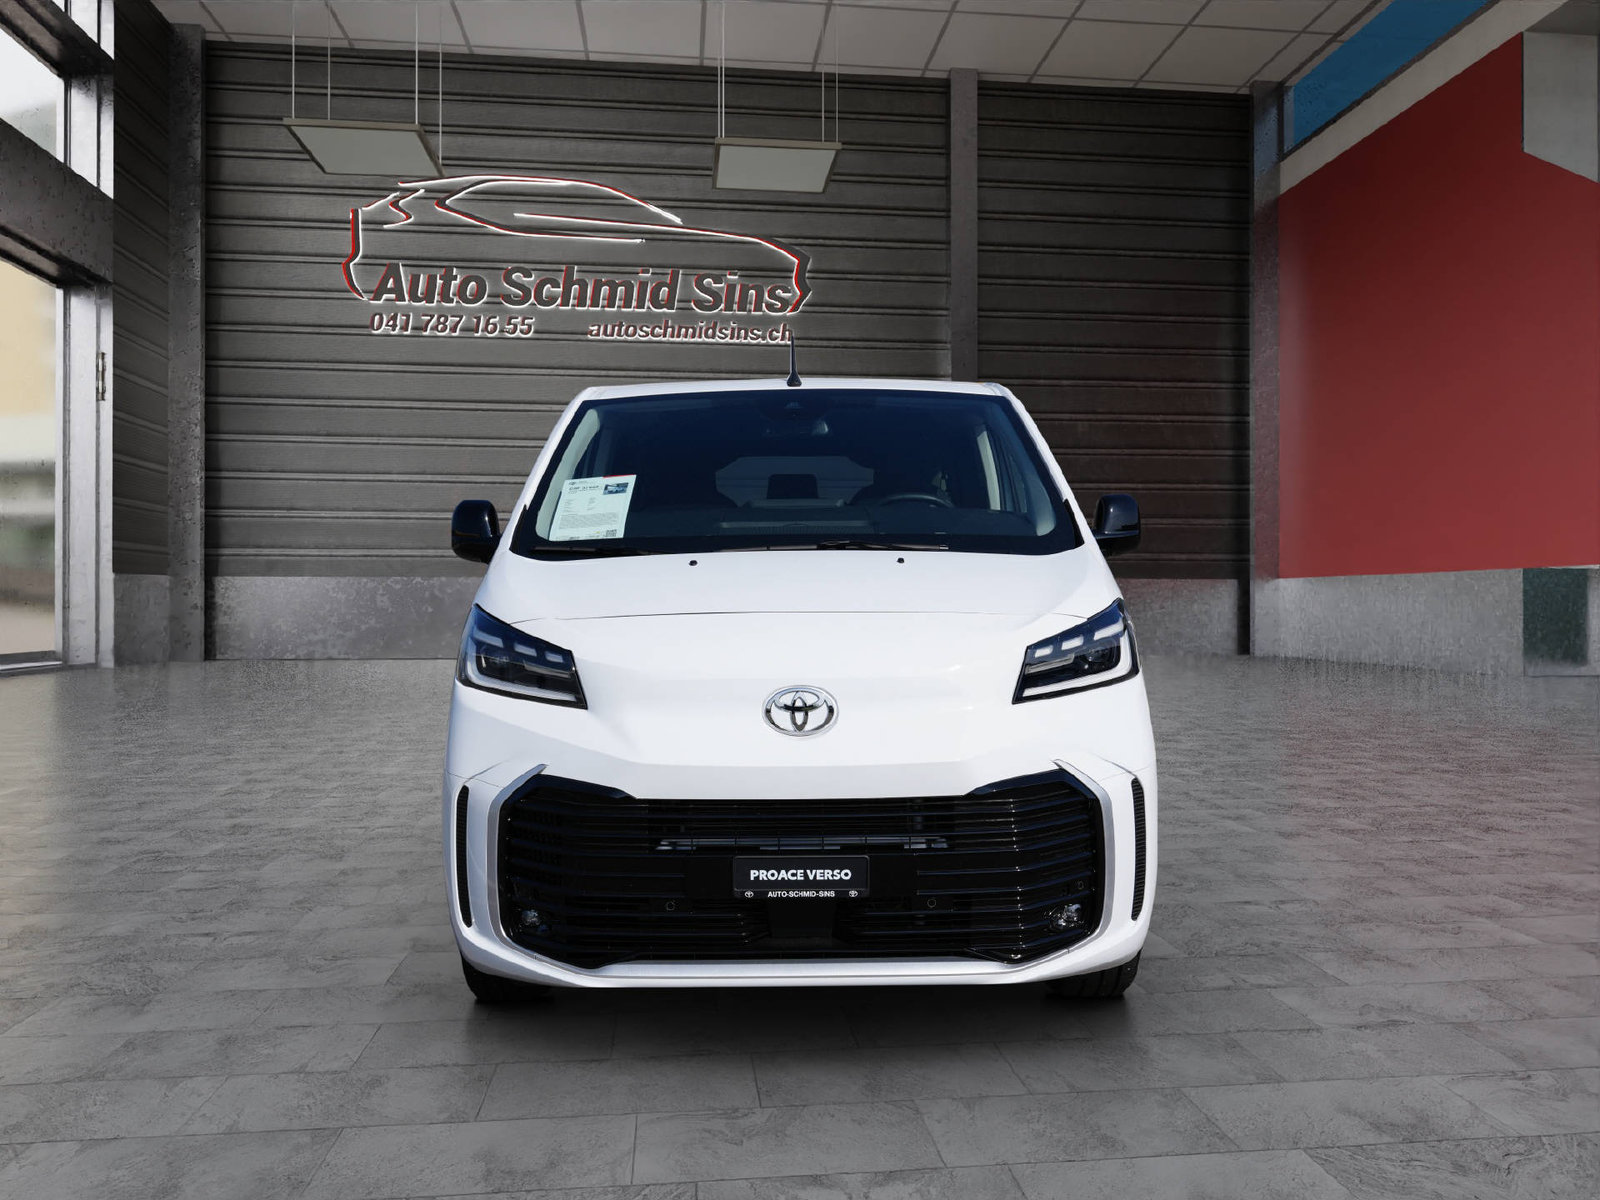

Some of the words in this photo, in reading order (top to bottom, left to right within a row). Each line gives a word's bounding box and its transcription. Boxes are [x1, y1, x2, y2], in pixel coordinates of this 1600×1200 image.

[370, 262, 487, 307] Auto
[500, 265, 682, 312] Schmid
[691, 270, 793, 315] Sins
[369, 313, 411, 335] 041
[421, 314, 465, 336] 787
[473, 315, 498, 336] 16
[505, 316, 534, 337] 55
[588, 320, 793, 344] autoschmidsins.ch
[750, 869, 804, 880] PROACE
[806, 869, 852, 880] VERSO
